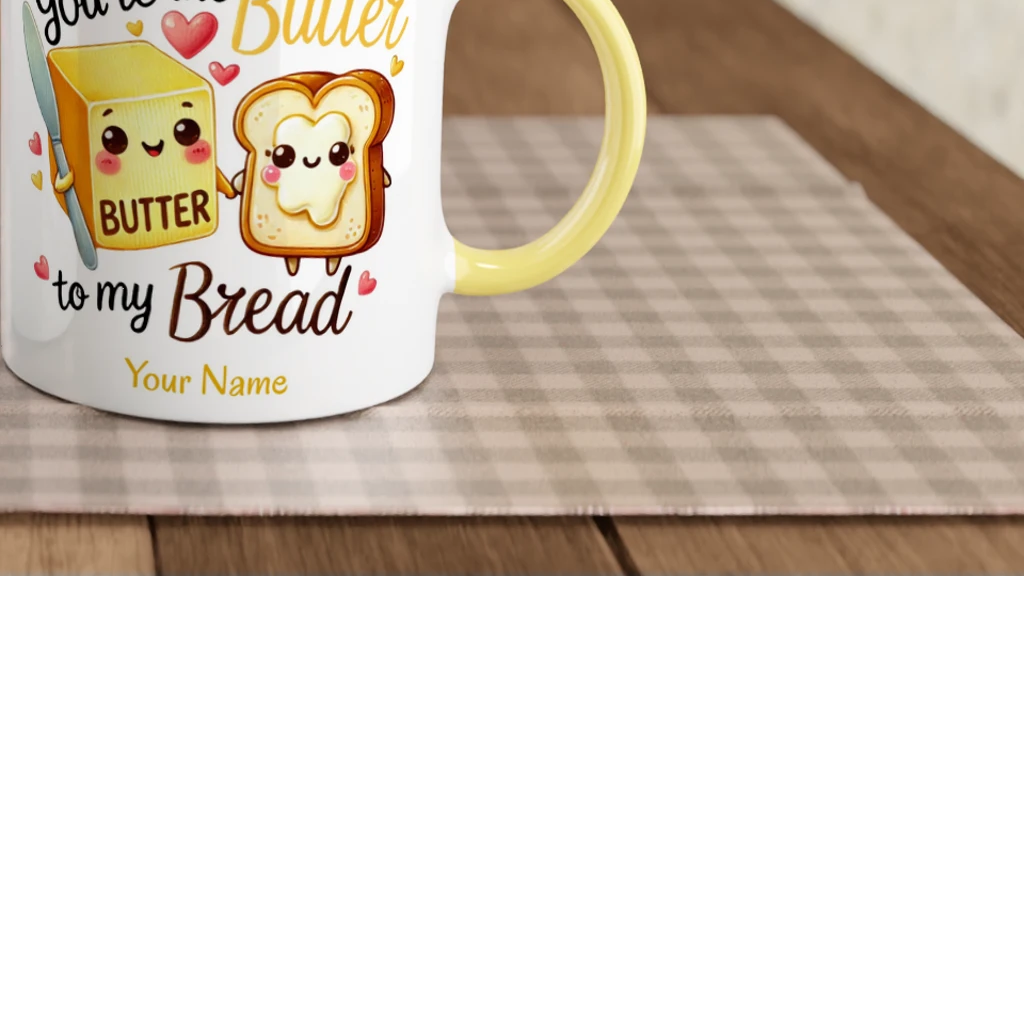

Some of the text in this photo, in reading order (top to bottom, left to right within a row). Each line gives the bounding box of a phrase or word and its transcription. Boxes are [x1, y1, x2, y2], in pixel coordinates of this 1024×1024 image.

[99, 189, 211, 237] BUTTER
[53, 261, 353, 342] to my Bread
[124, 358, 288, 397] Your Name
